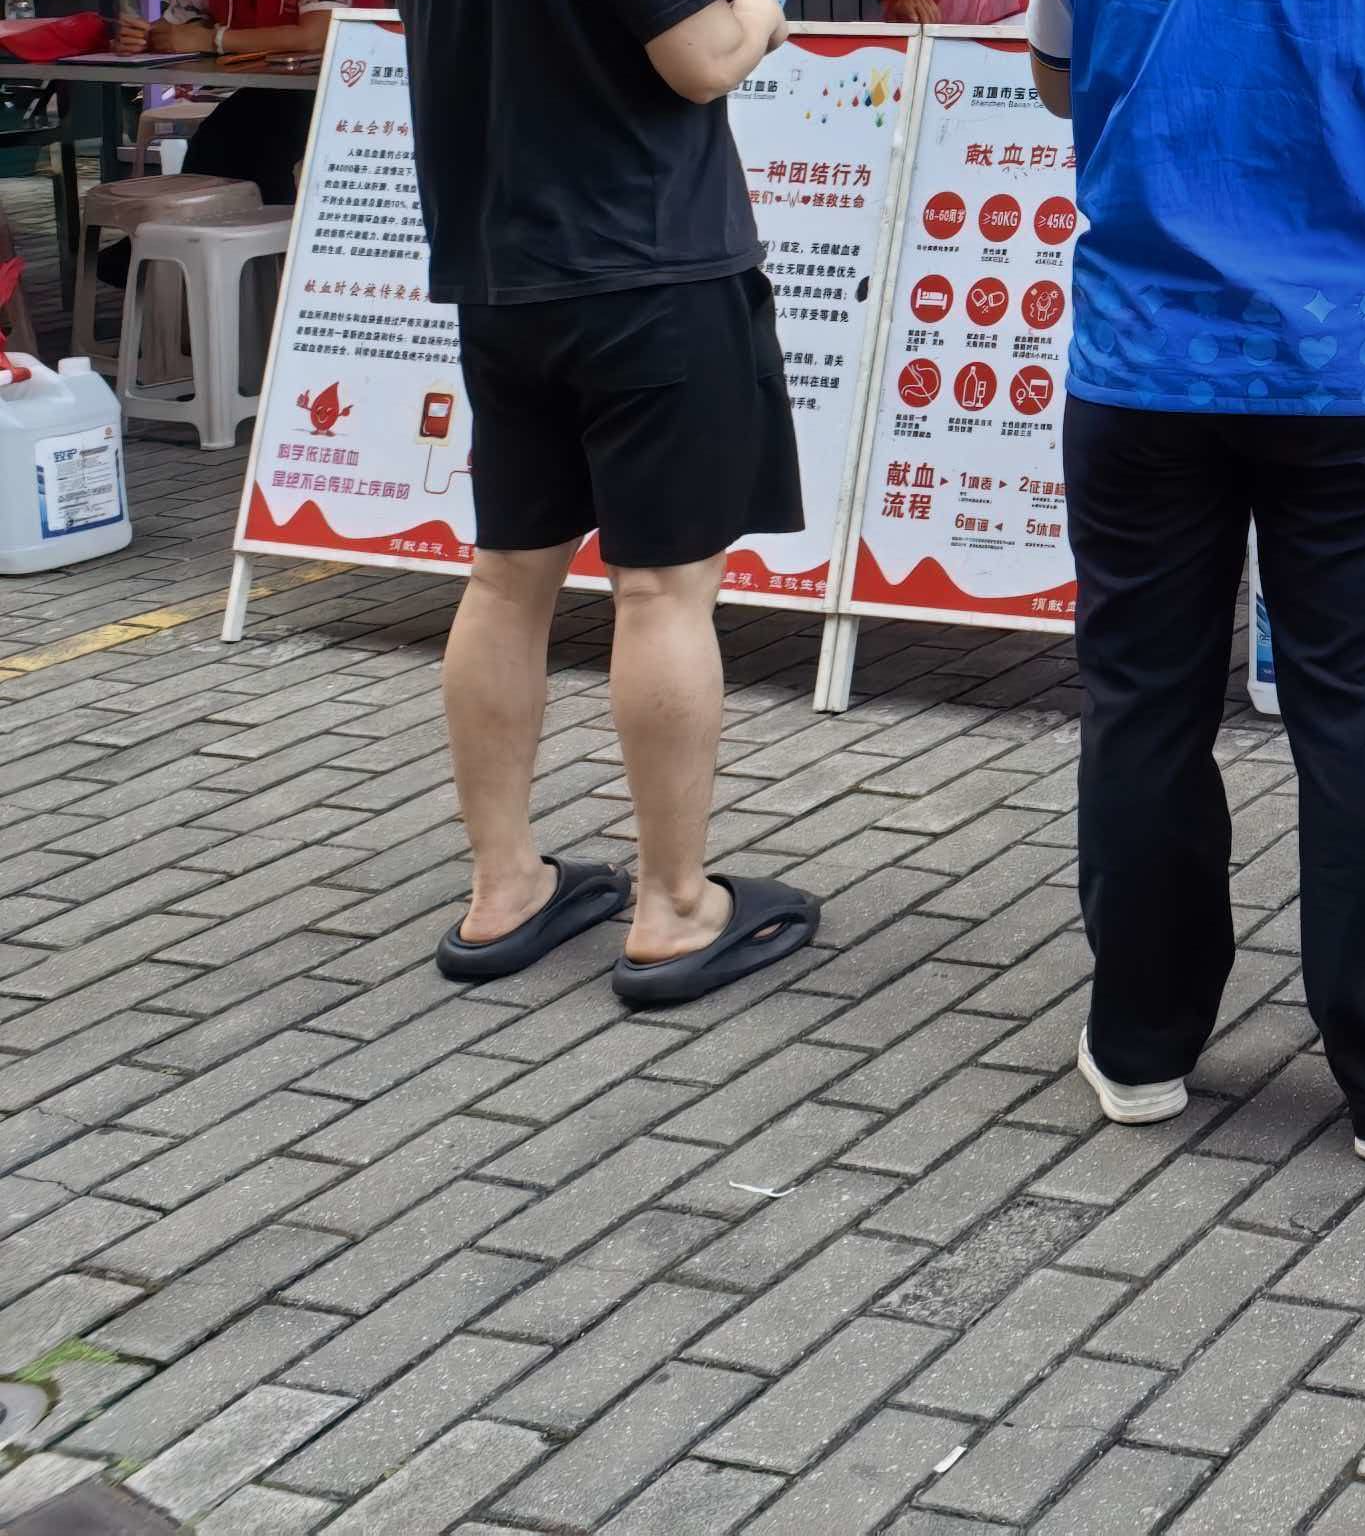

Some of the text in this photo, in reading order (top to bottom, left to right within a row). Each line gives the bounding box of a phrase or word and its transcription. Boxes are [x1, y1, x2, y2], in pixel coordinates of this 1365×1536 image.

[747, 160, 871, 186] 一种团结行为
[812, 193, 864, 209] 拯救生命
[277, 443, 360, 466] 科学依法献血
[272, 470, 410, 500] 是绝不会传染上疾病的
[886, 461, 935, 489] 献血
[881, 491, 932, 520] 流程
